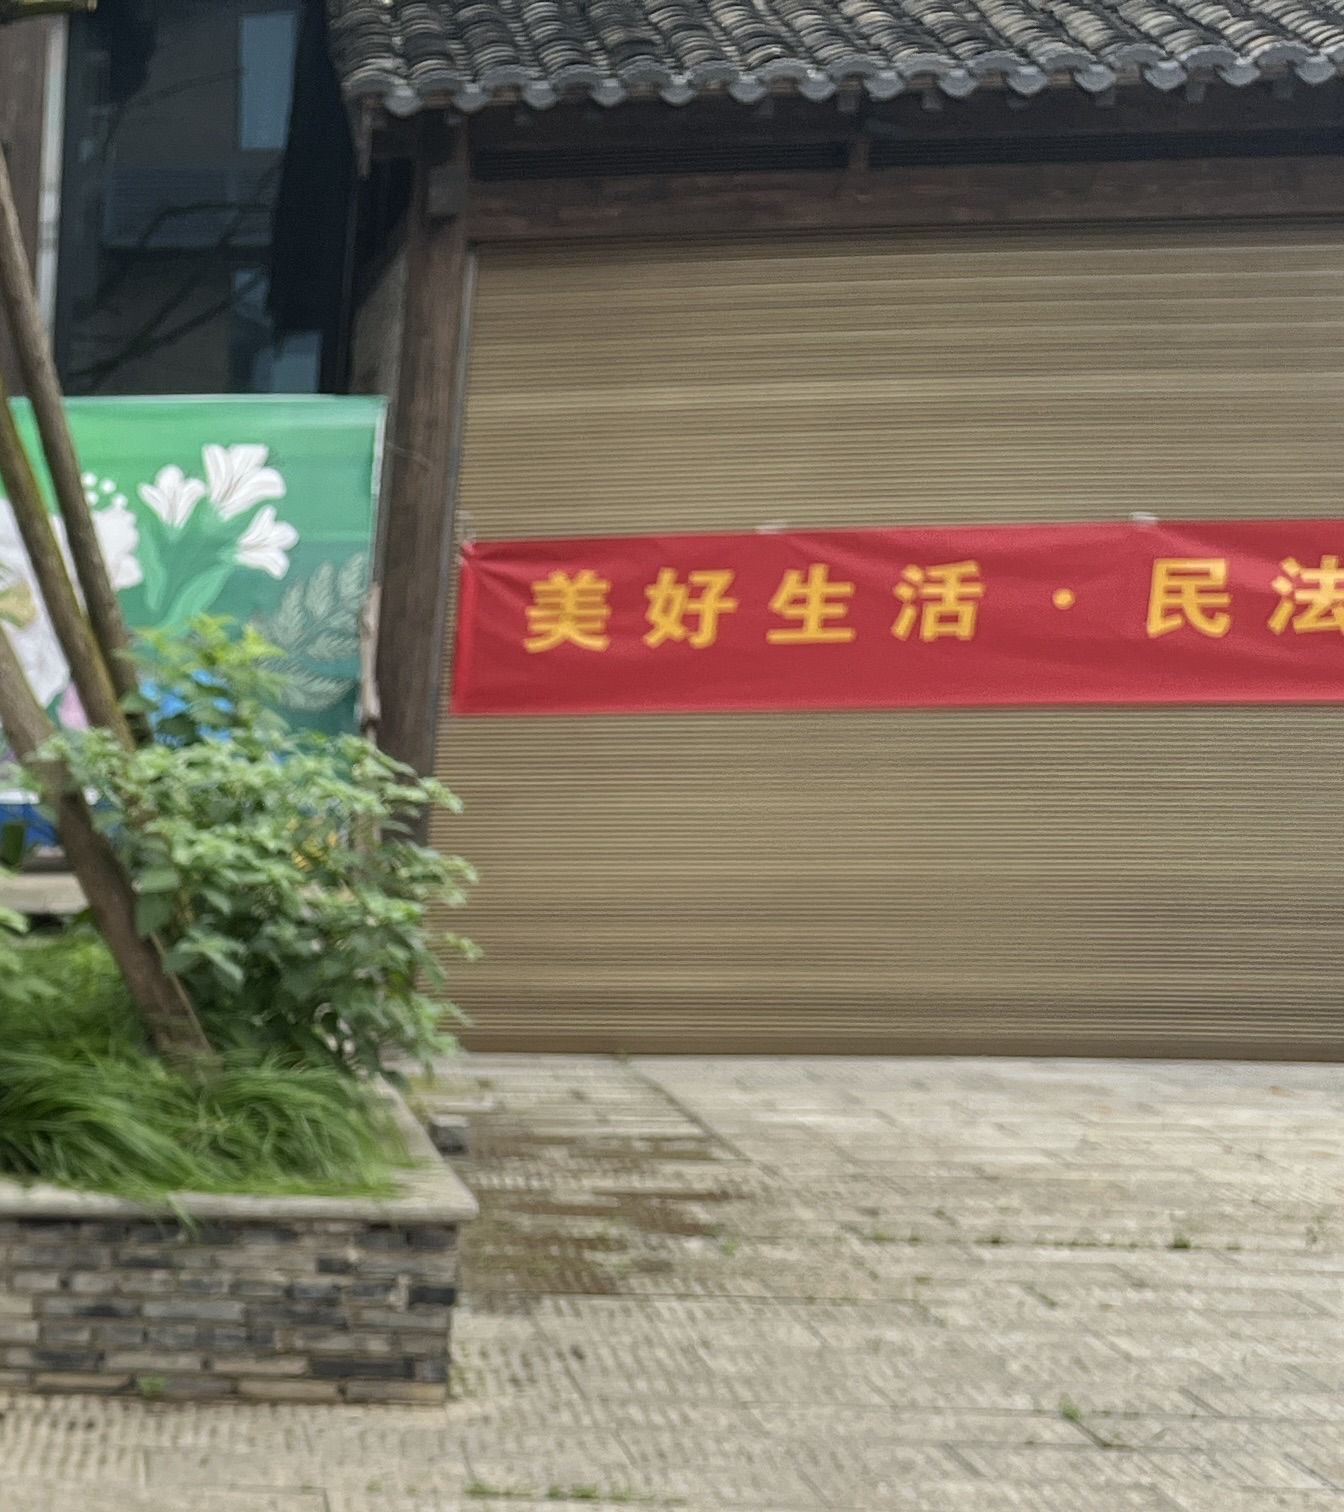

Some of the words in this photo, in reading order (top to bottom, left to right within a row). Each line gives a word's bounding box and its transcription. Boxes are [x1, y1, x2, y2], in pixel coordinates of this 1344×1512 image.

[522, 553, 1344, 654] 美好生活·民法
